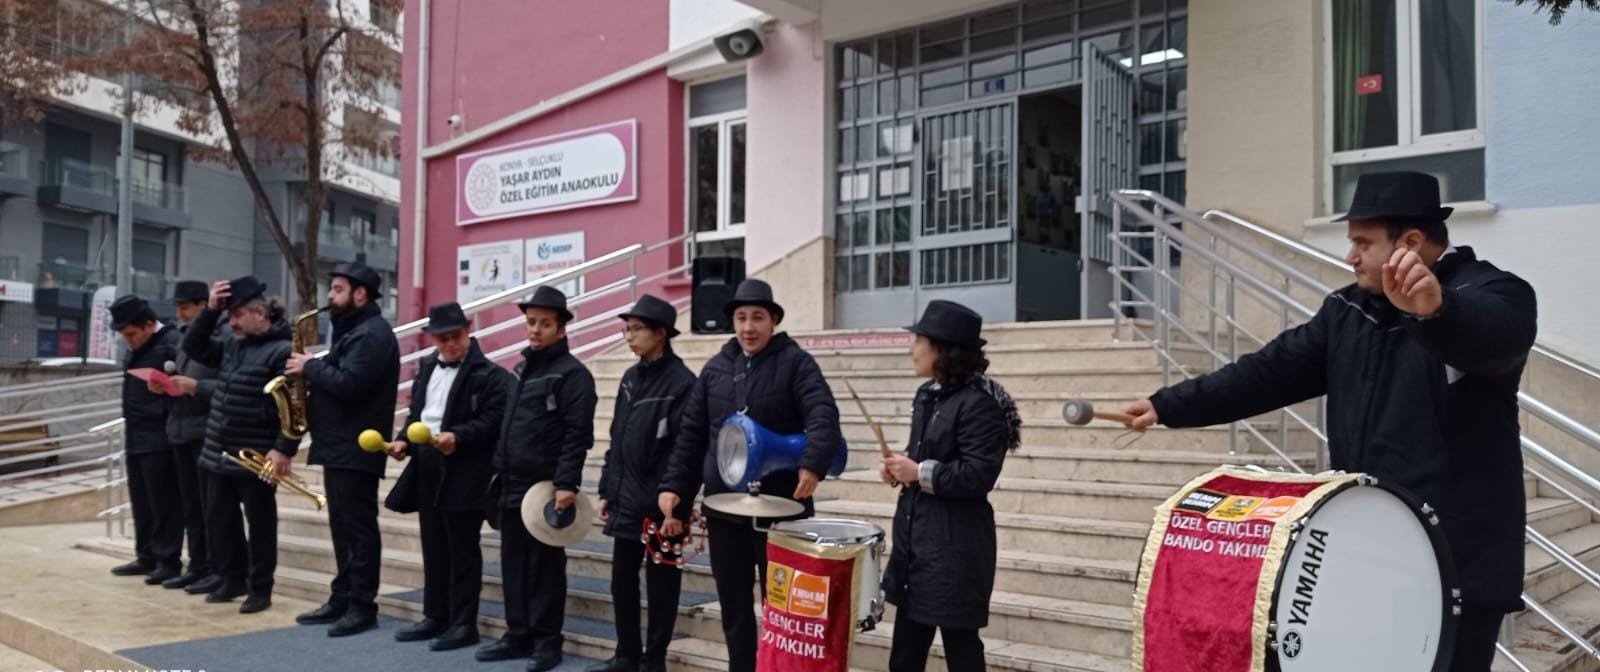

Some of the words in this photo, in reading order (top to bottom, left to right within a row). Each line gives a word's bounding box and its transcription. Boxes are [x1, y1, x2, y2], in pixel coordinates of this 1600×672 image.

[500, 189, 523, 204] ÖZEL
[525, 183, 558, 200] EĞİTİM
[560, 172, 619, 194] ANAOKULU
[501, 171, 529, 187] YAŞAR
[531, 166, 561, 181] AYDIN
[1171, 511, 1203, 531] ÖZEL
[1207, 520, 1272, 539] GENÇLER
[1164, 533, 1214, 552] BANDO
[1218, 540, 1268, 558] TAKIMI
[1287, 528, 1329, 626] YAMAHA
[769, 611, 825, 639] GENÇLER
[776, 633, 826, 659] TAKIMI
